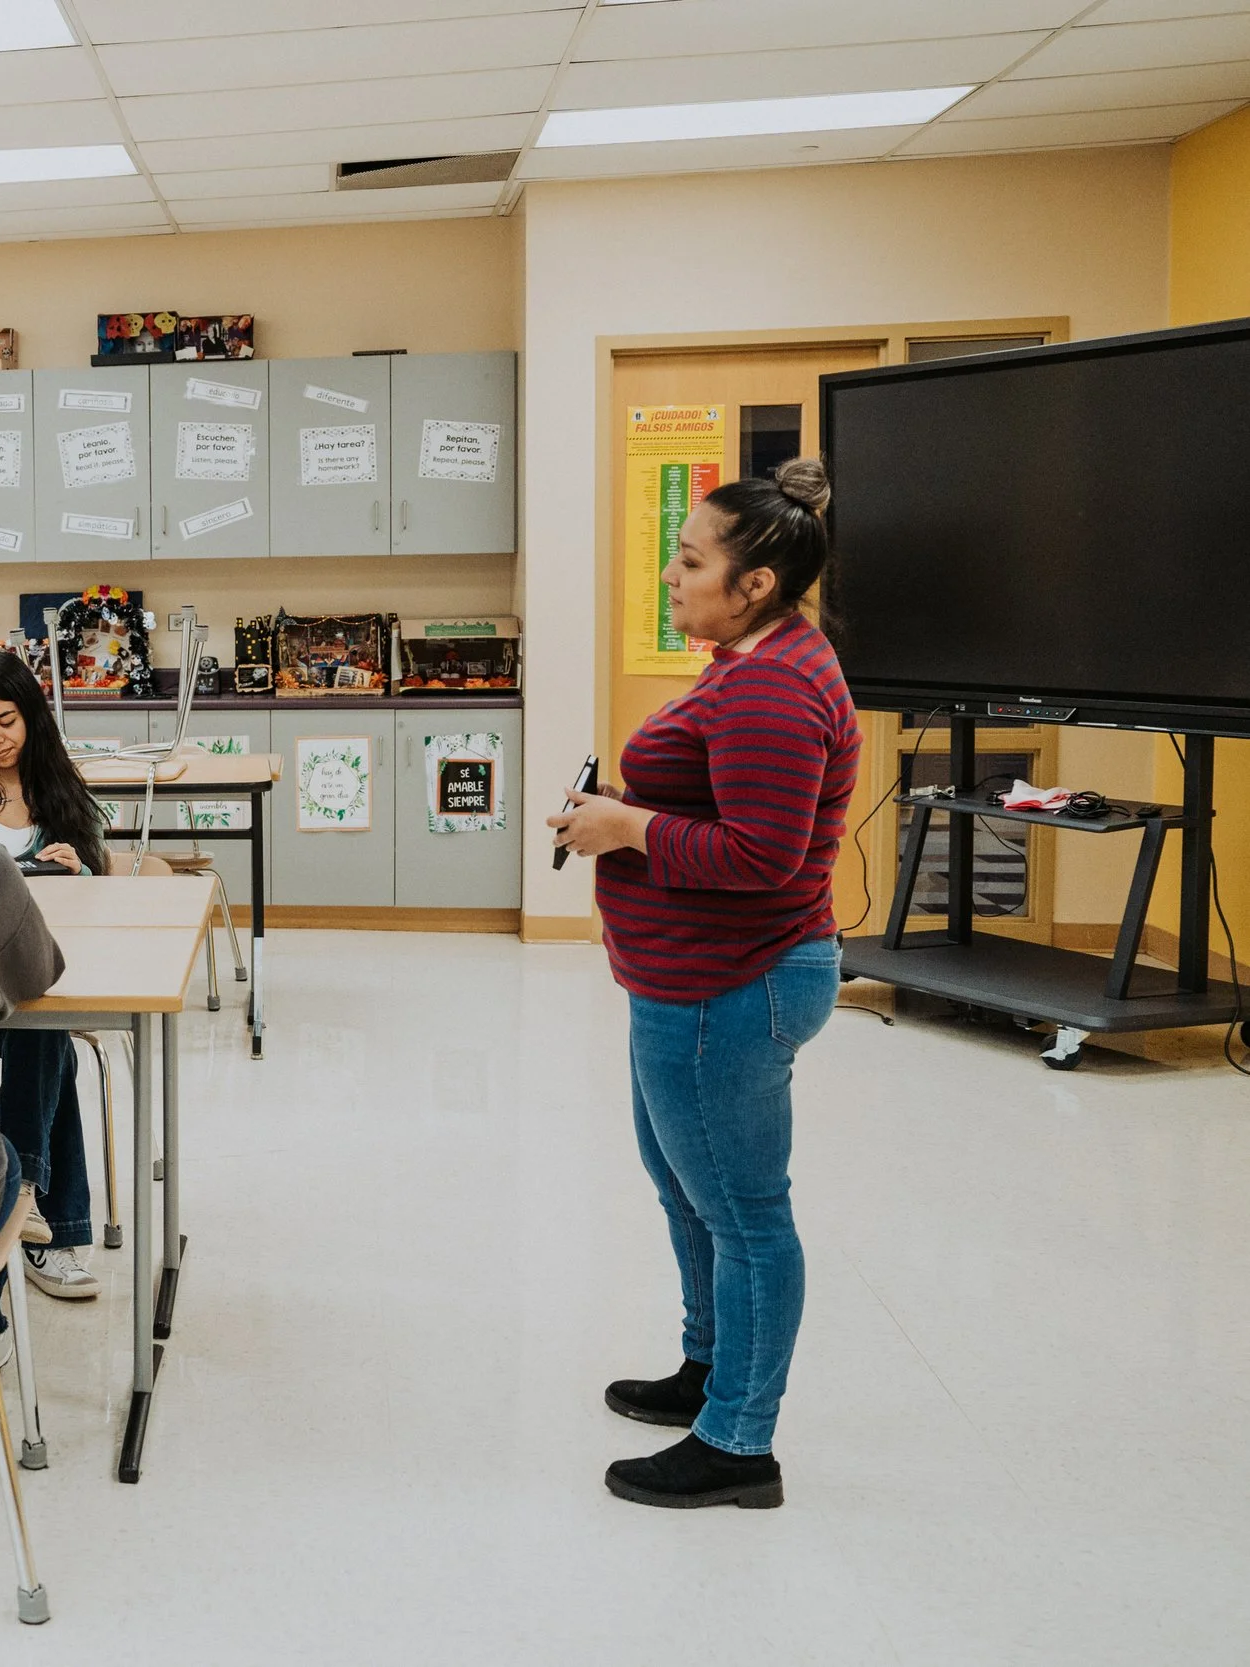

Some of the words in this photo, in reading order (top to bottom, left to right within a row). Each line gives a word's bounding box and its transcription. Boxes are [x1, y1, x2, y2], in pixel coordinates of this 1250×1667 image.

[317, 391, 356, 408] diferente
[651, 410, 702, 422] ¡CUIDADO!
[636, 423, 672, 433] FALSOS
[674, 422, 714, 432] AMIGOS
[314, 443, 335, 451] ¿Hay
[337, 440, 365, 449] tarea?
[458, 445, 482, 454] favor.
[78, 451, 92, 460] por
[94, 447, 118, 456] favor.
[460, 767, 470, 778] SÉ
[448, 781, 484, 793] AMABLE
[448, 796, 485, 808] SIEMPRE
